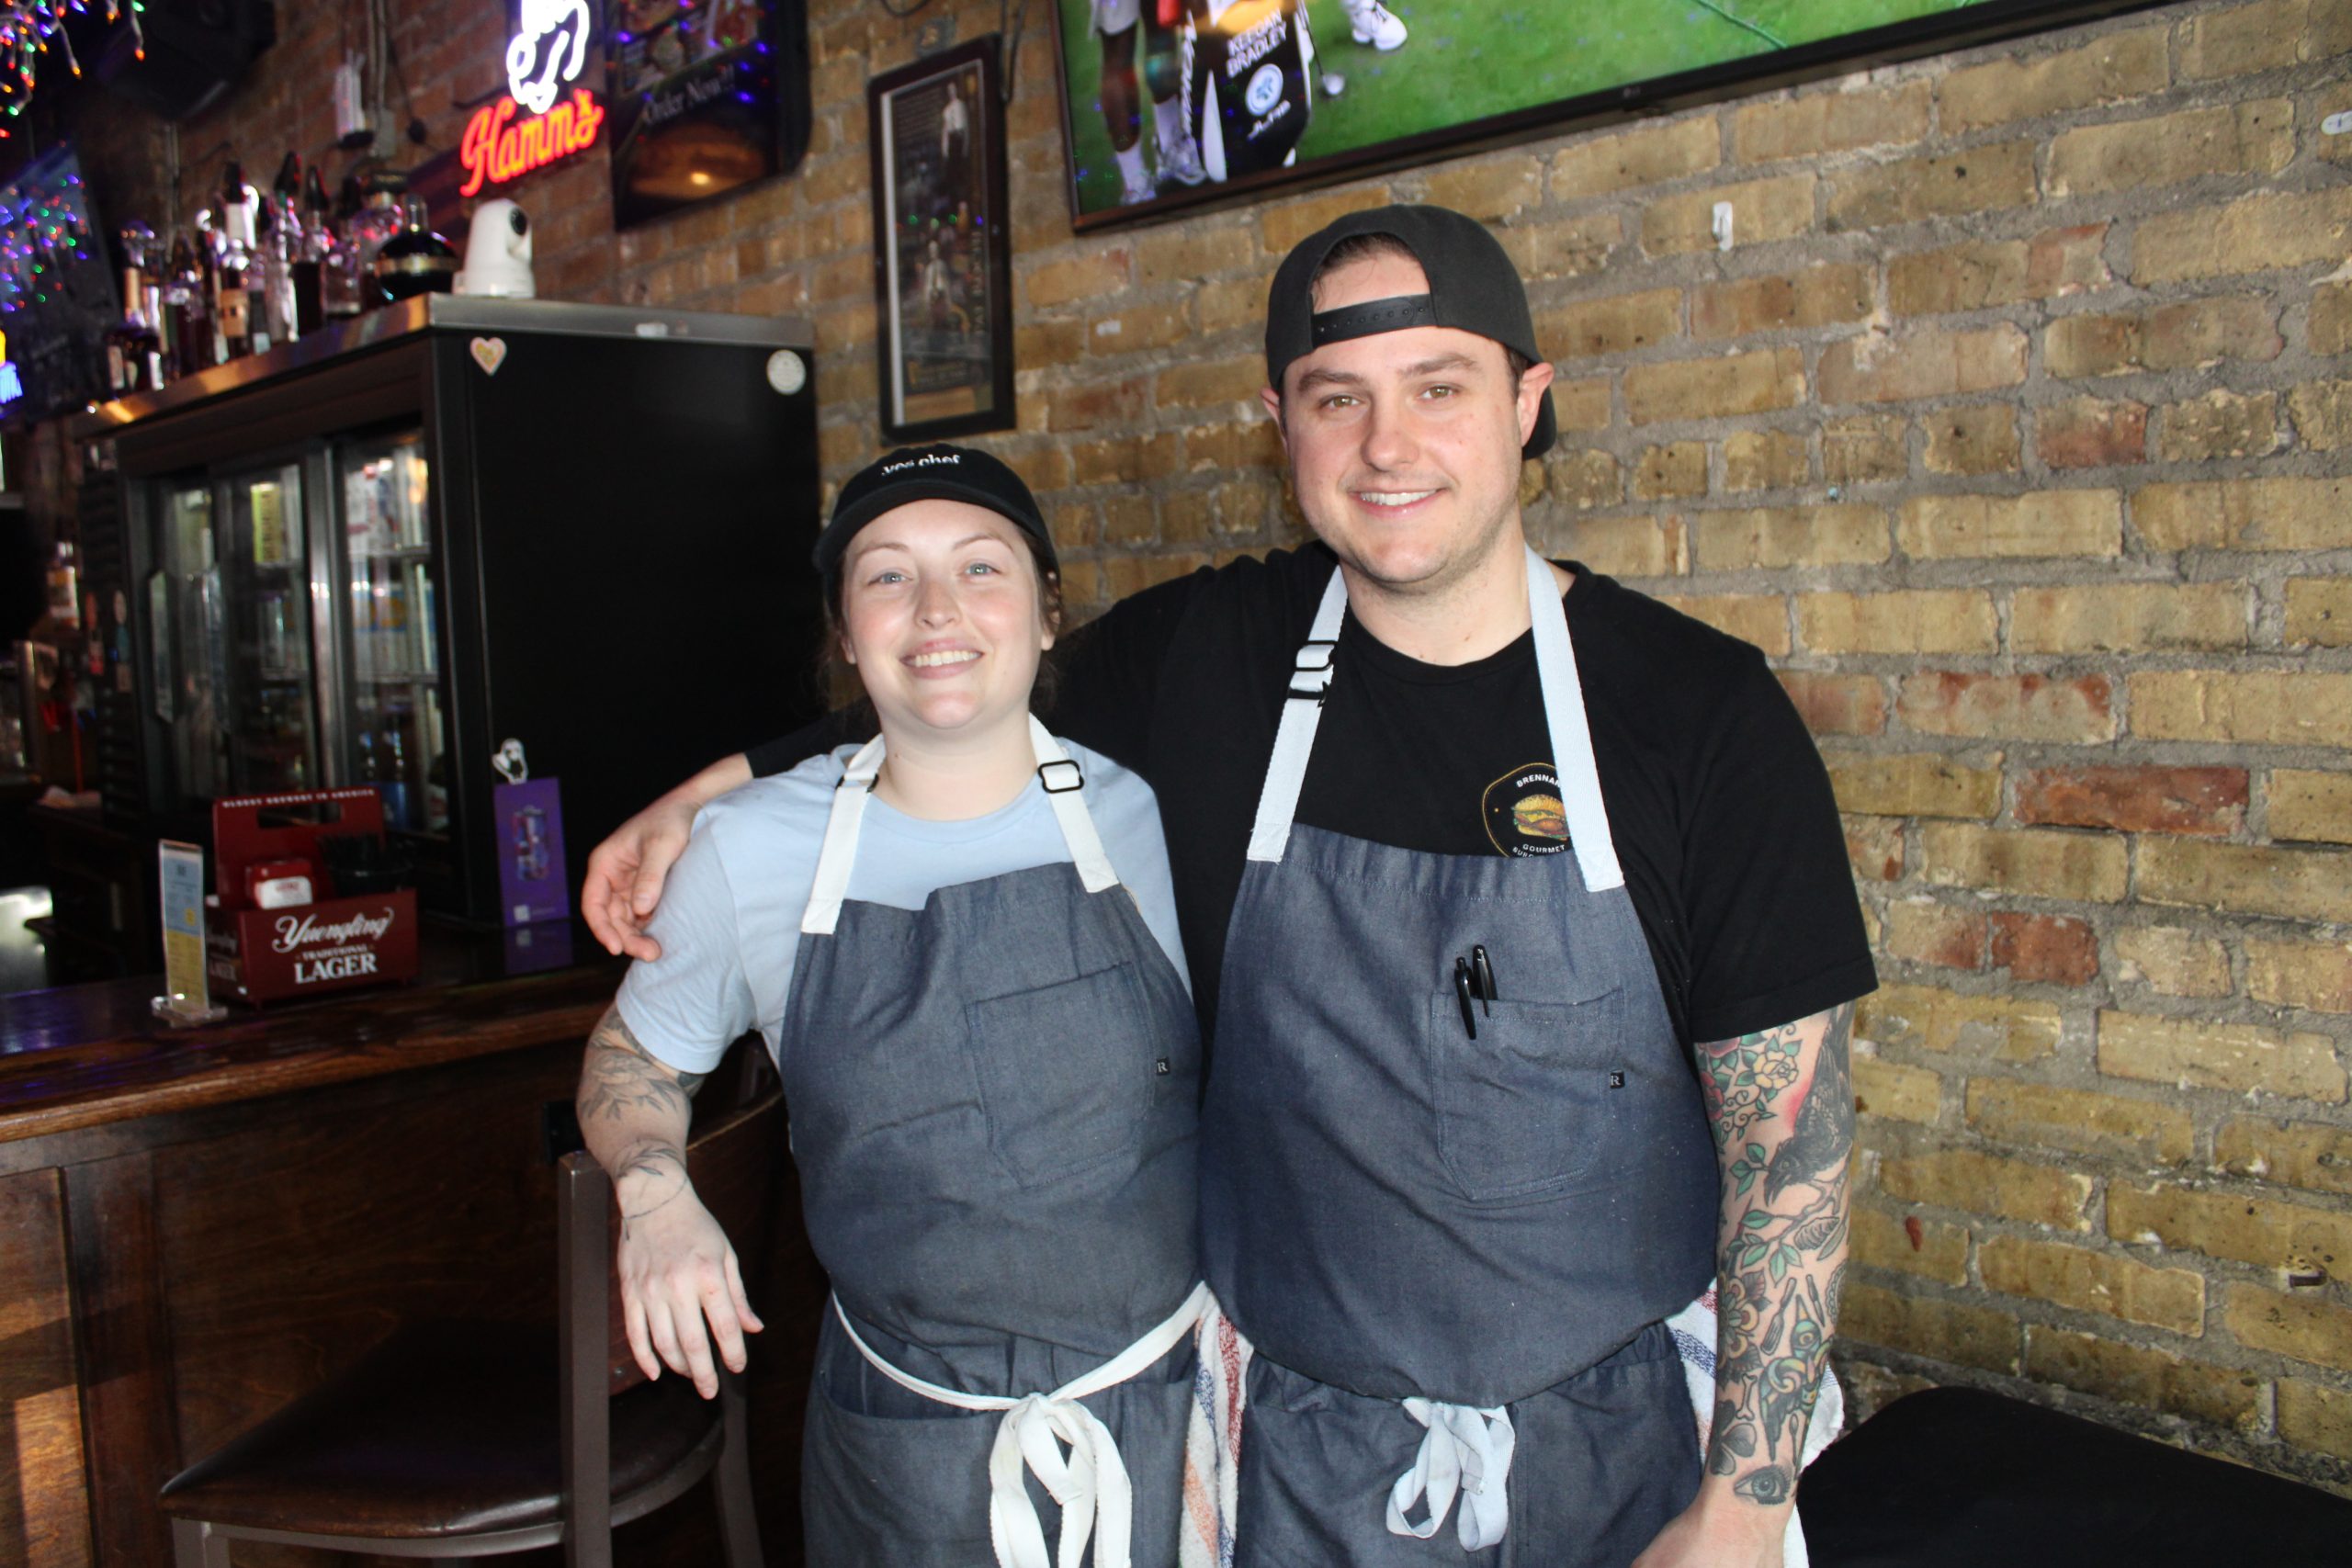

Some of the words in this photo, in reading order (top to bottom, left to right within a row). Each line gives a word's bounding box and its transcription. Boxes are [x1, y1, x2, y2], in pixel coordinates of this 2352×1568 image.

[1226, 20, 1286, 78] BRADLEY
[1227, 7, 1283, 57] KEEGAN
[459, 88, 605, 197] Hamm's
[1522, 843, 1566, 853] GOURMET
[272, 907, 395, 953] Yuengling
[301, 943, 368, 961] TRADITIONAL
[294, 953, 379, 985] LAGER
